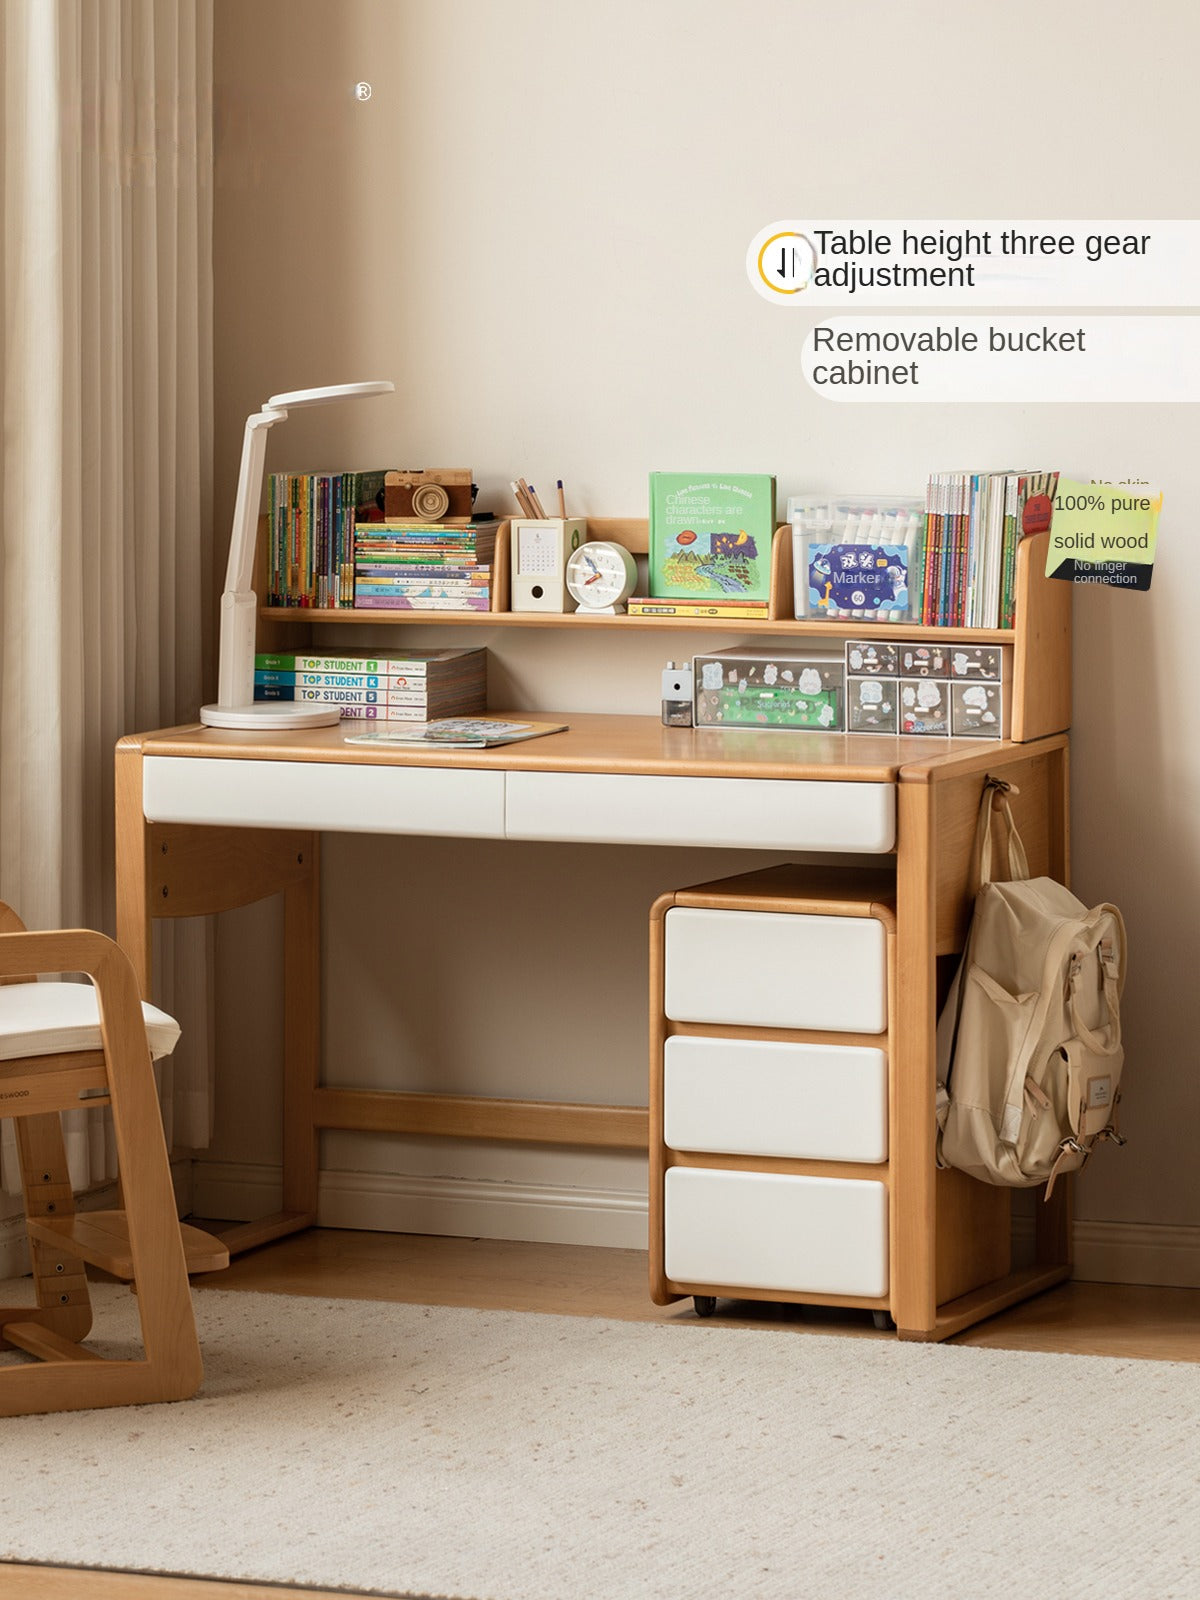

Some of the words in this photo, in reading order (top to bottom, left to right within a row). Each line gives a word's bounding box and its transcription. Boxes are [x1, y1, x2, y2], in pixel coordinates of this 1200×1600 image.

[666, 494, 710, 505] Chinese
[666, 505, 722, 515] characters
[725, 506, 743, 515] are
[833, 571, 881, 584] Marker
[302, 659, 321, 669] TOP
[324, 660, 363, 671] STUDENT
[303, 675, 322, 685] TOP
[324, 675, 364, 687] STUDENT
[301, 690, 321, 700] TOP
[323, 691, 362, 702] STUDENT
